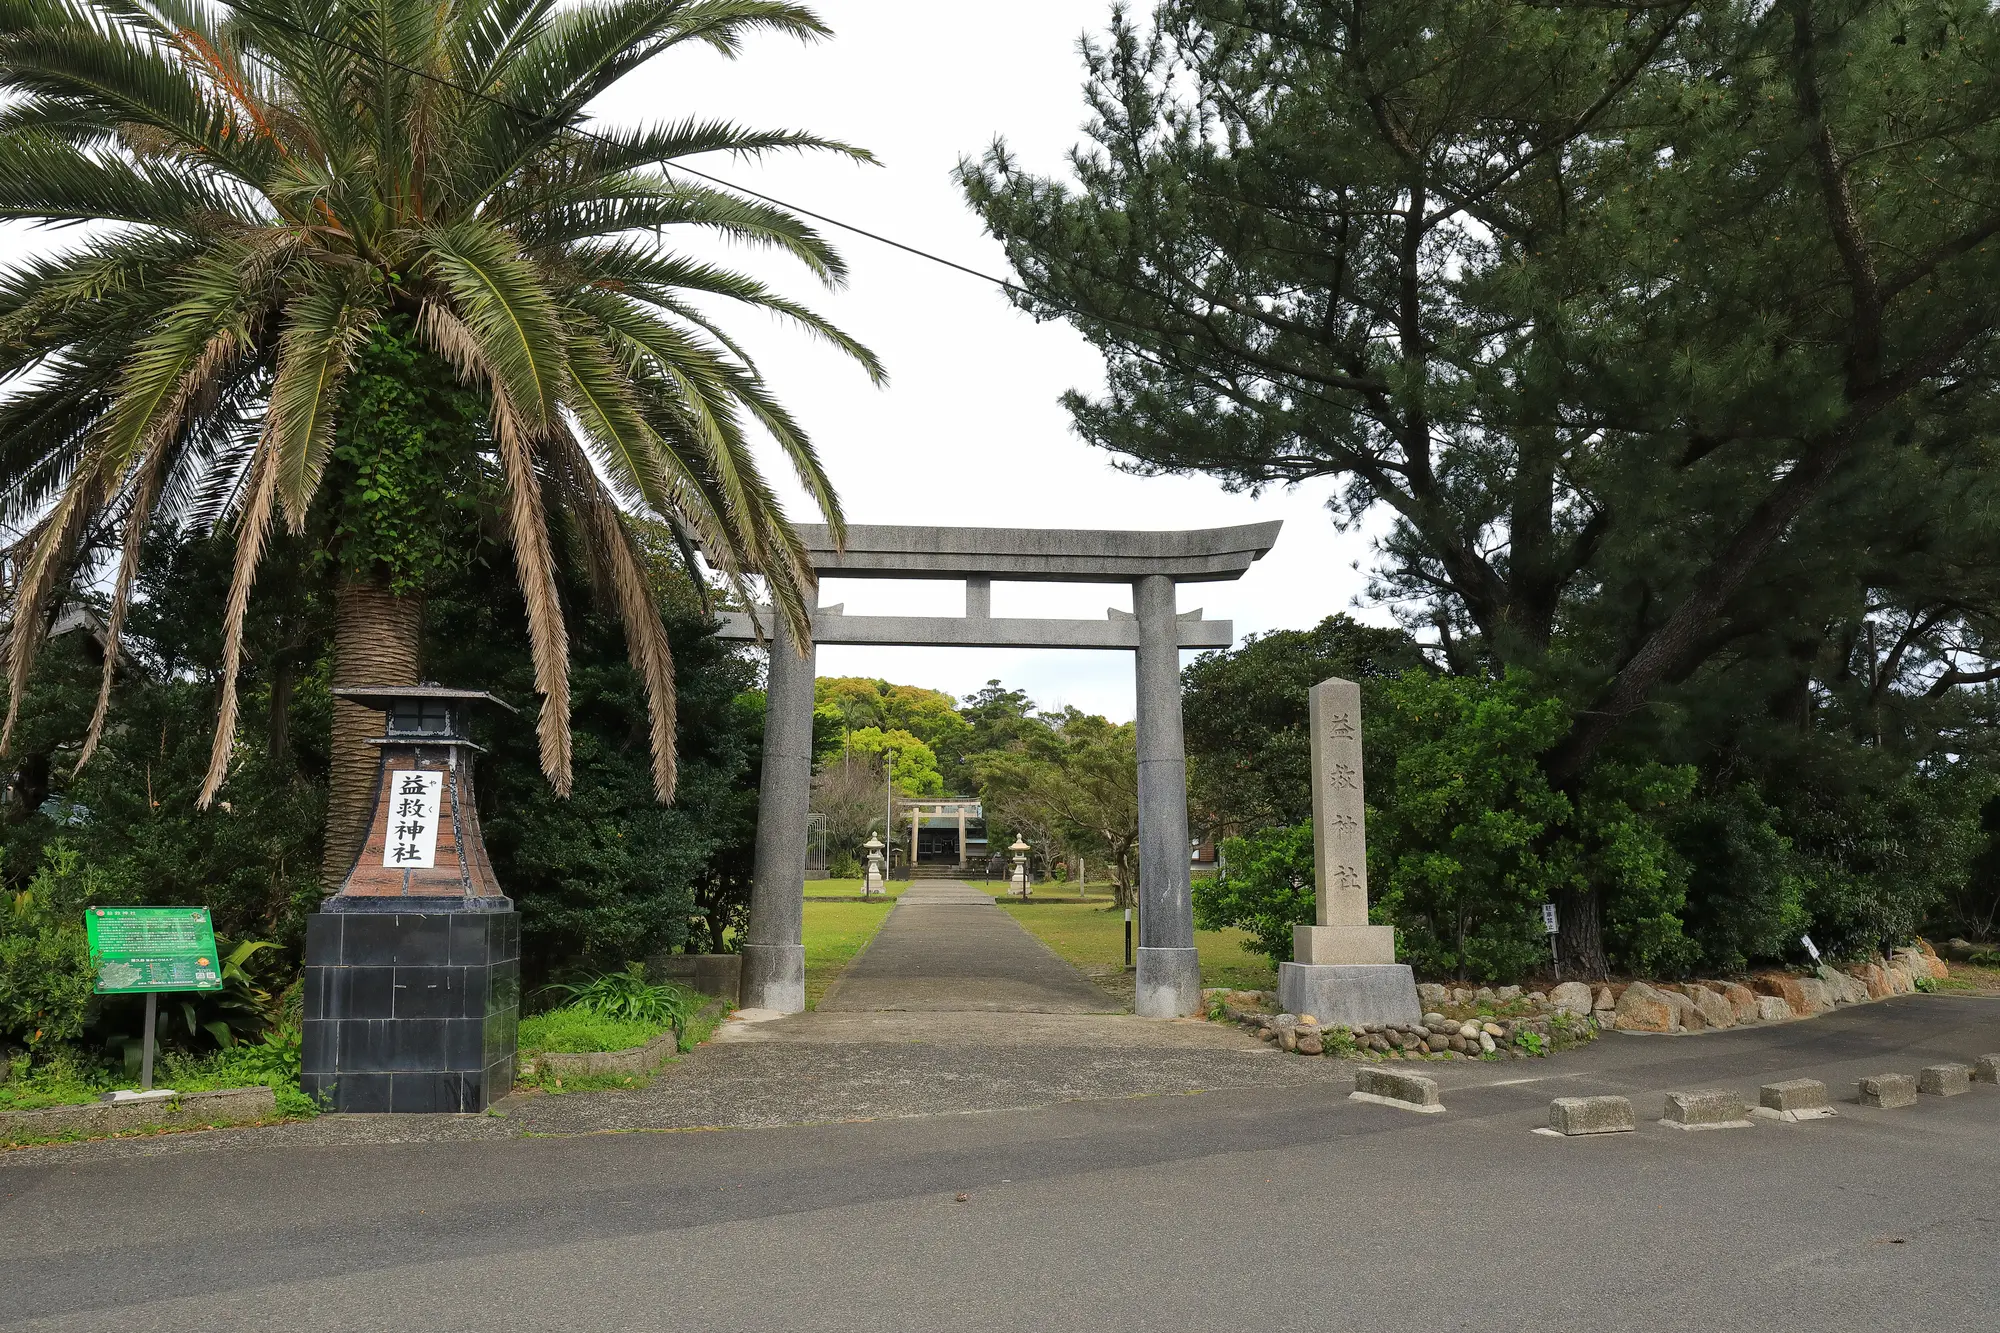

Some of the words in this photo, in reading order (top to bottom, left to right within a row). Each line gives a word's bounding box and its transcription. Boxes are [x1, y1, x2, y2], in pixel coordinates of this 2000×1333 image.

[391, 774, 429, 864] 益救神社
[1330, 712, 1361, 890] 益救神社
[1545, 905, 1554, 930] 駐車禁止
